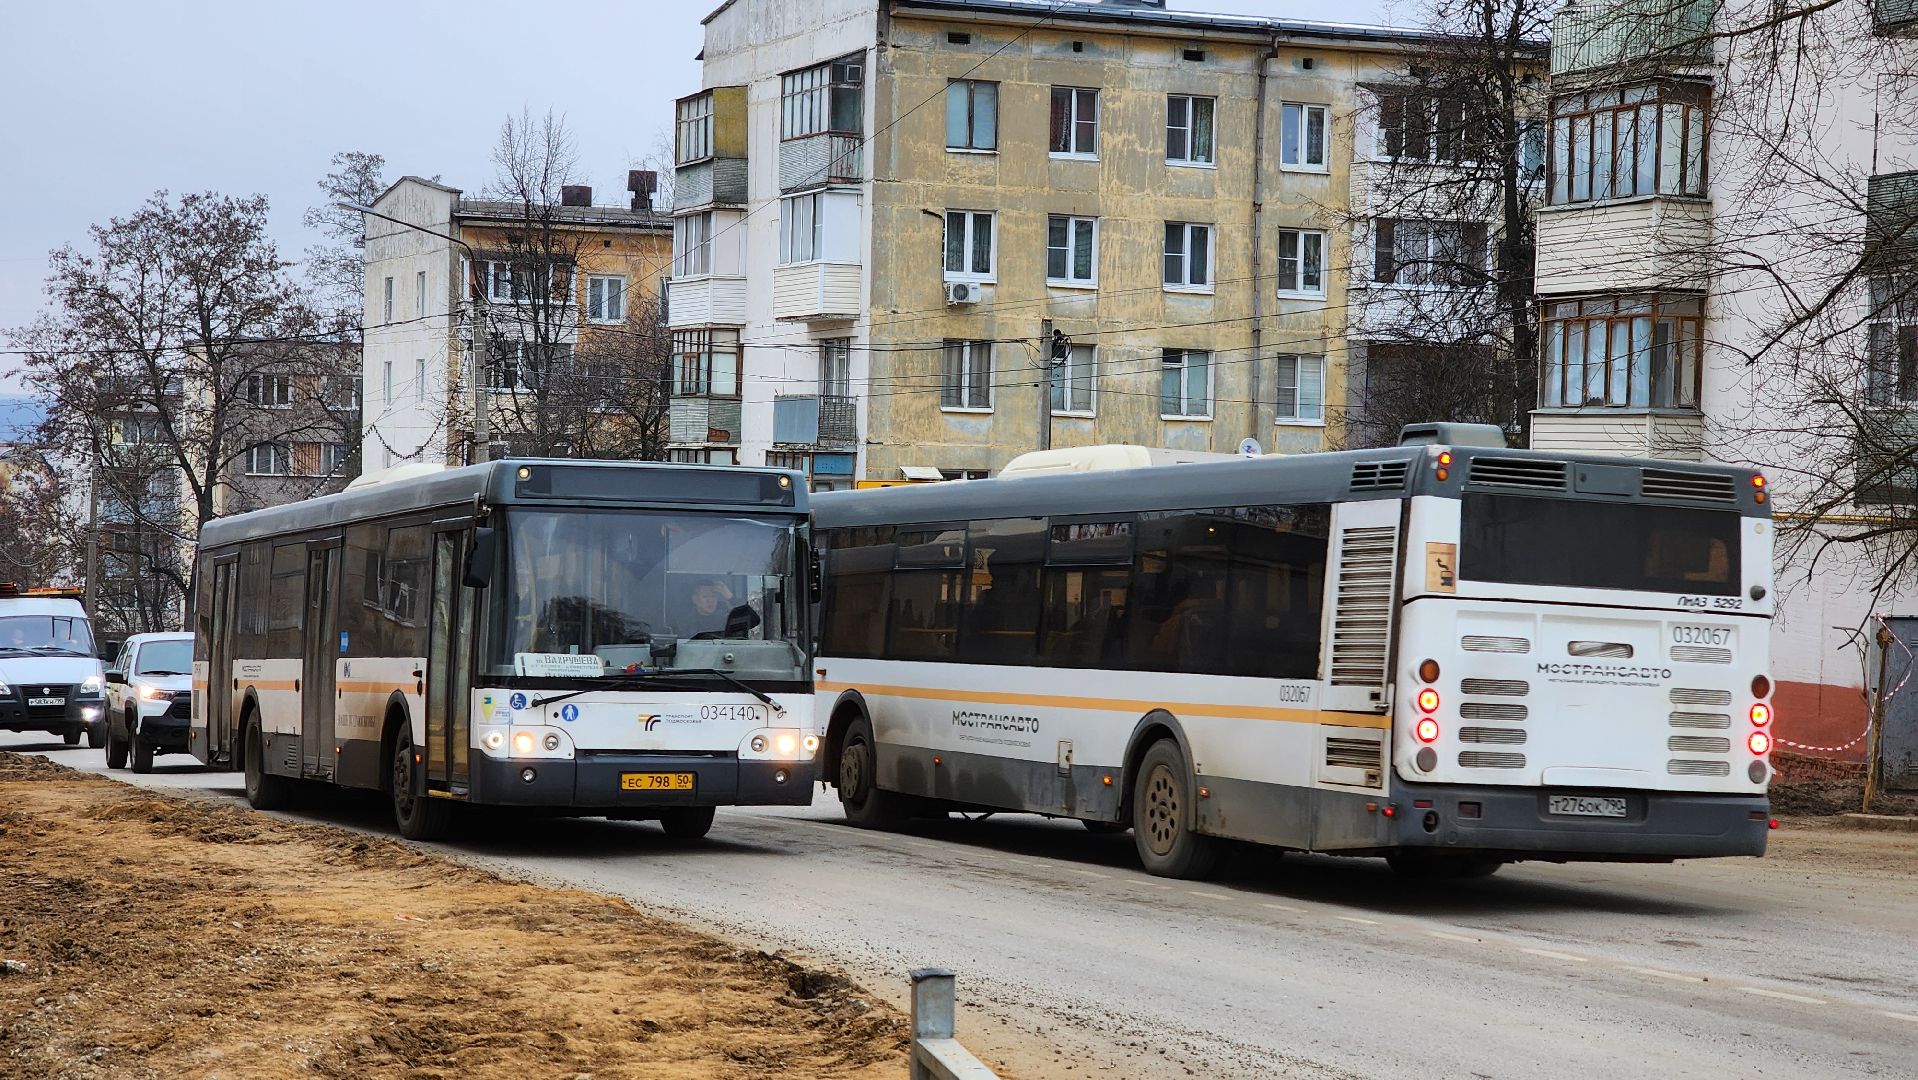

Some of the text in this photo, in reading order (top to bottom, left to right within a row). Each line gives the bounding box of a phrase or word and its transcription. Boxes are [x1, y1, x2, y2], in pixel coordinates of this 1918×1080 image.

[1713, 597, 1743, 610] 5292
[1673, 626, 1731, 645] 032067
[1537, 662, 1672, 680] МОСТРАНСАВТО
[1280, 684, 1311, 703] 032067
[700, 705, 755, 721] 034140
[952, 710, 1039, 733] МОСТРАНСАВТО
[648, 775, 670, 788] 798
[677, 774, 689, 785] 50
